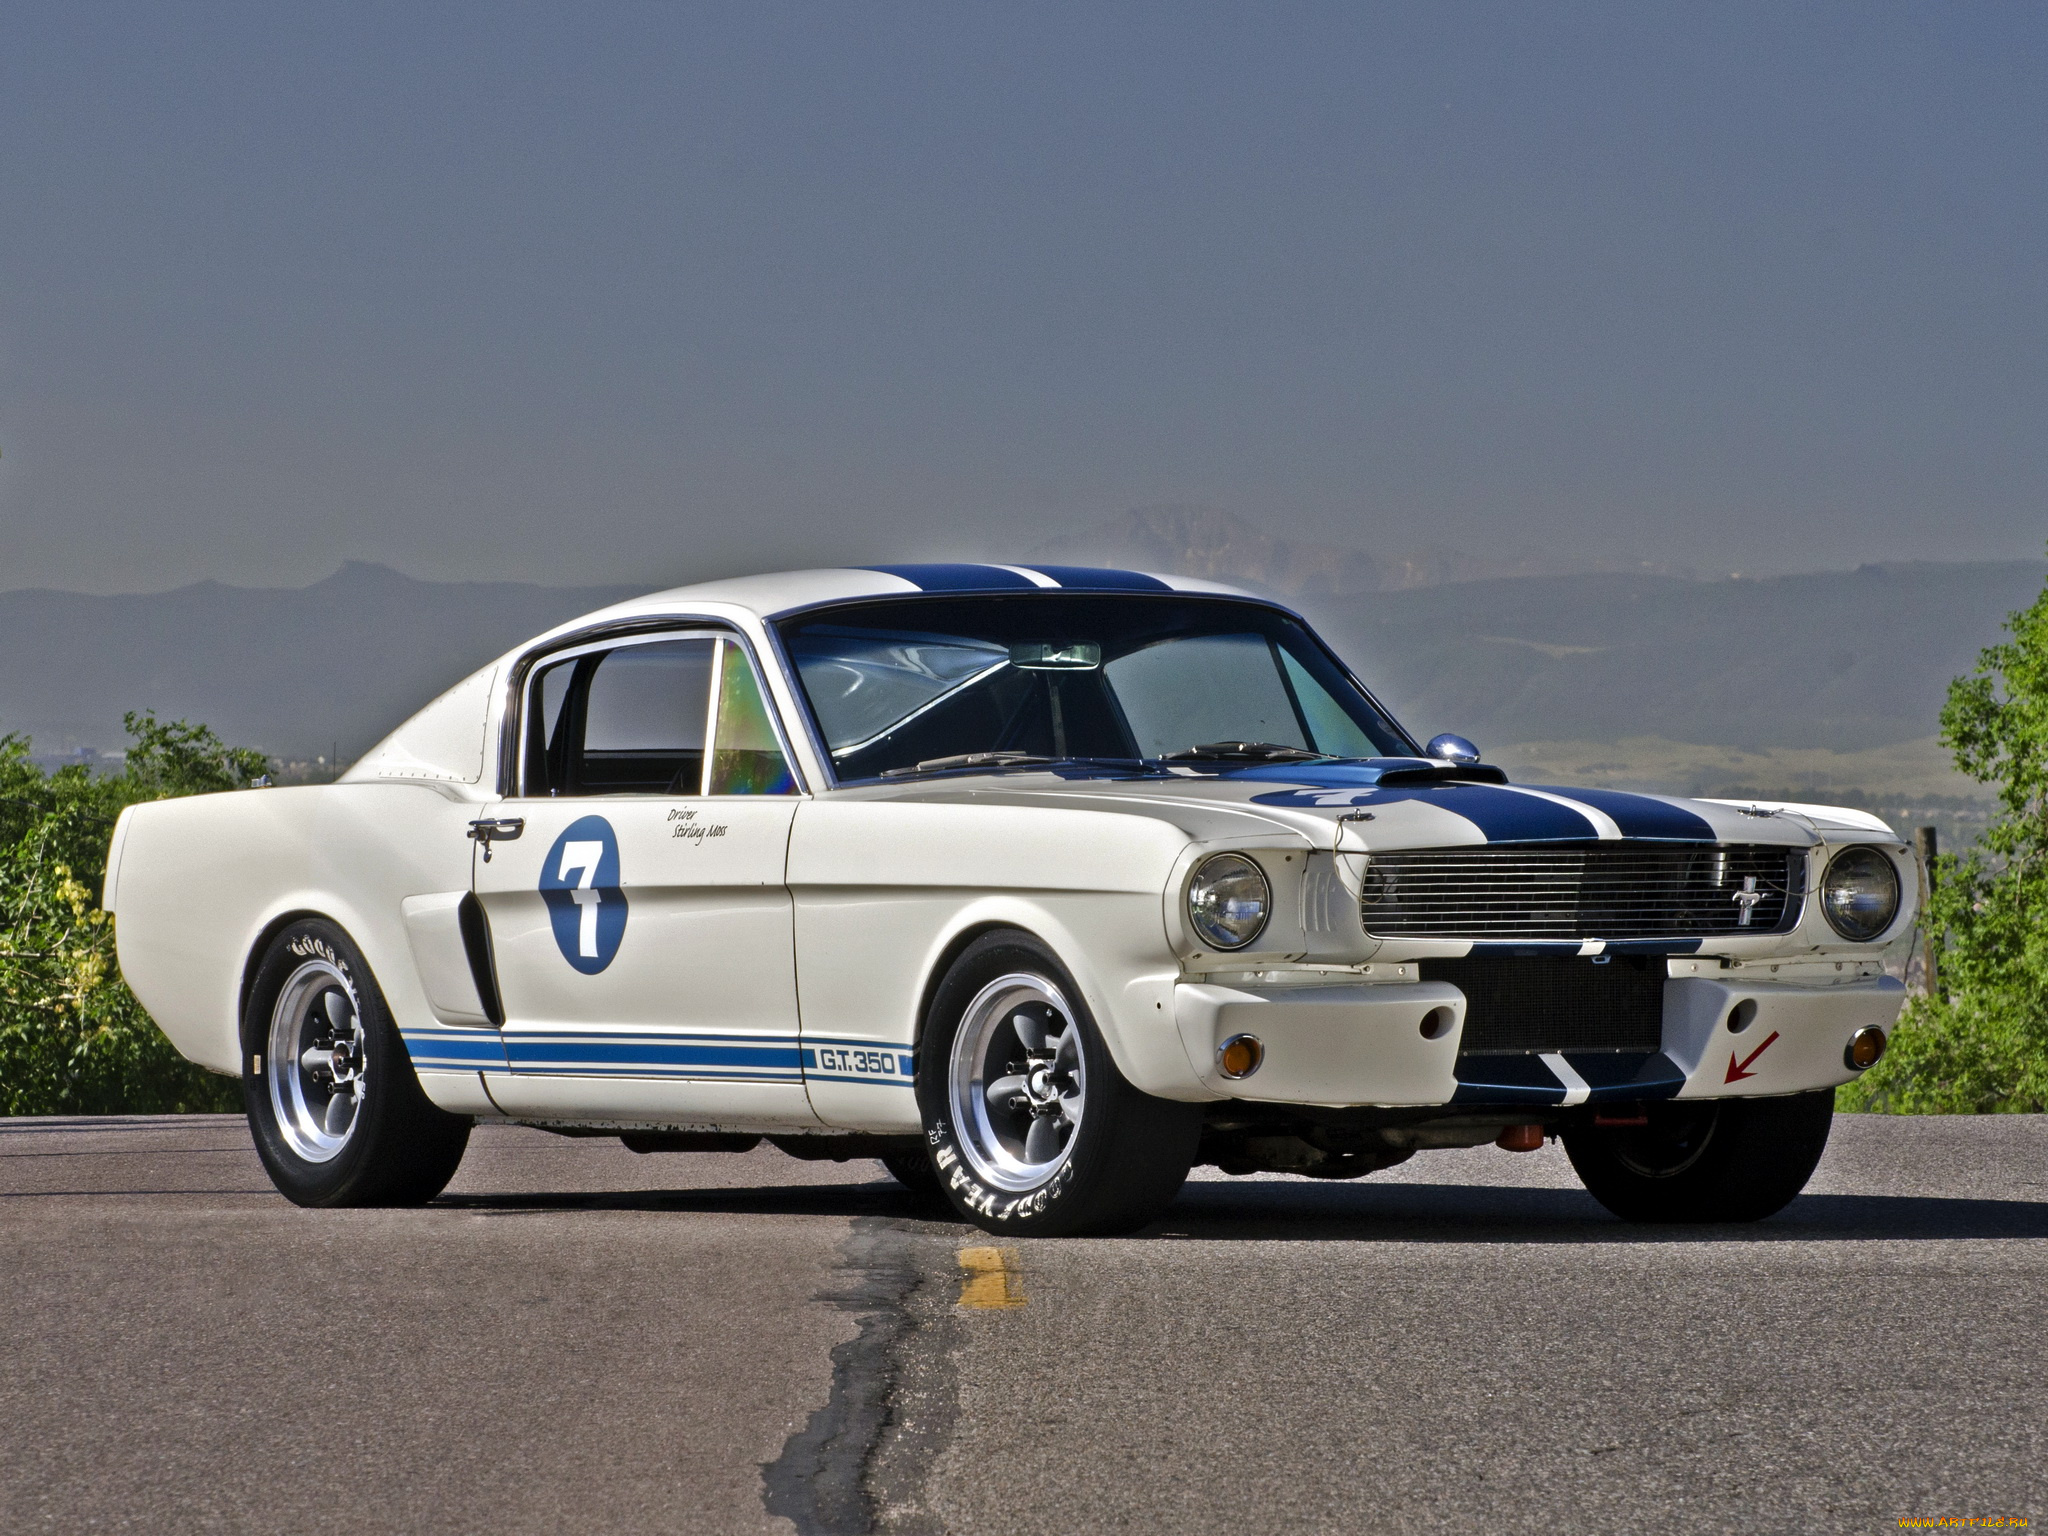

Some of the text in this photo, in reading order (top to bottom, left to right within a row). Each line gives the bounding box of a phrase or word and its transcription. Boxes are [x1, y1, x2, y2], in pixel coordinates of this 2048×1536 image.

[667, 805, 699, 822] Driver
[672, 822, 728, 847] Stirling Moss
[557, 840, 604, 958] 7
